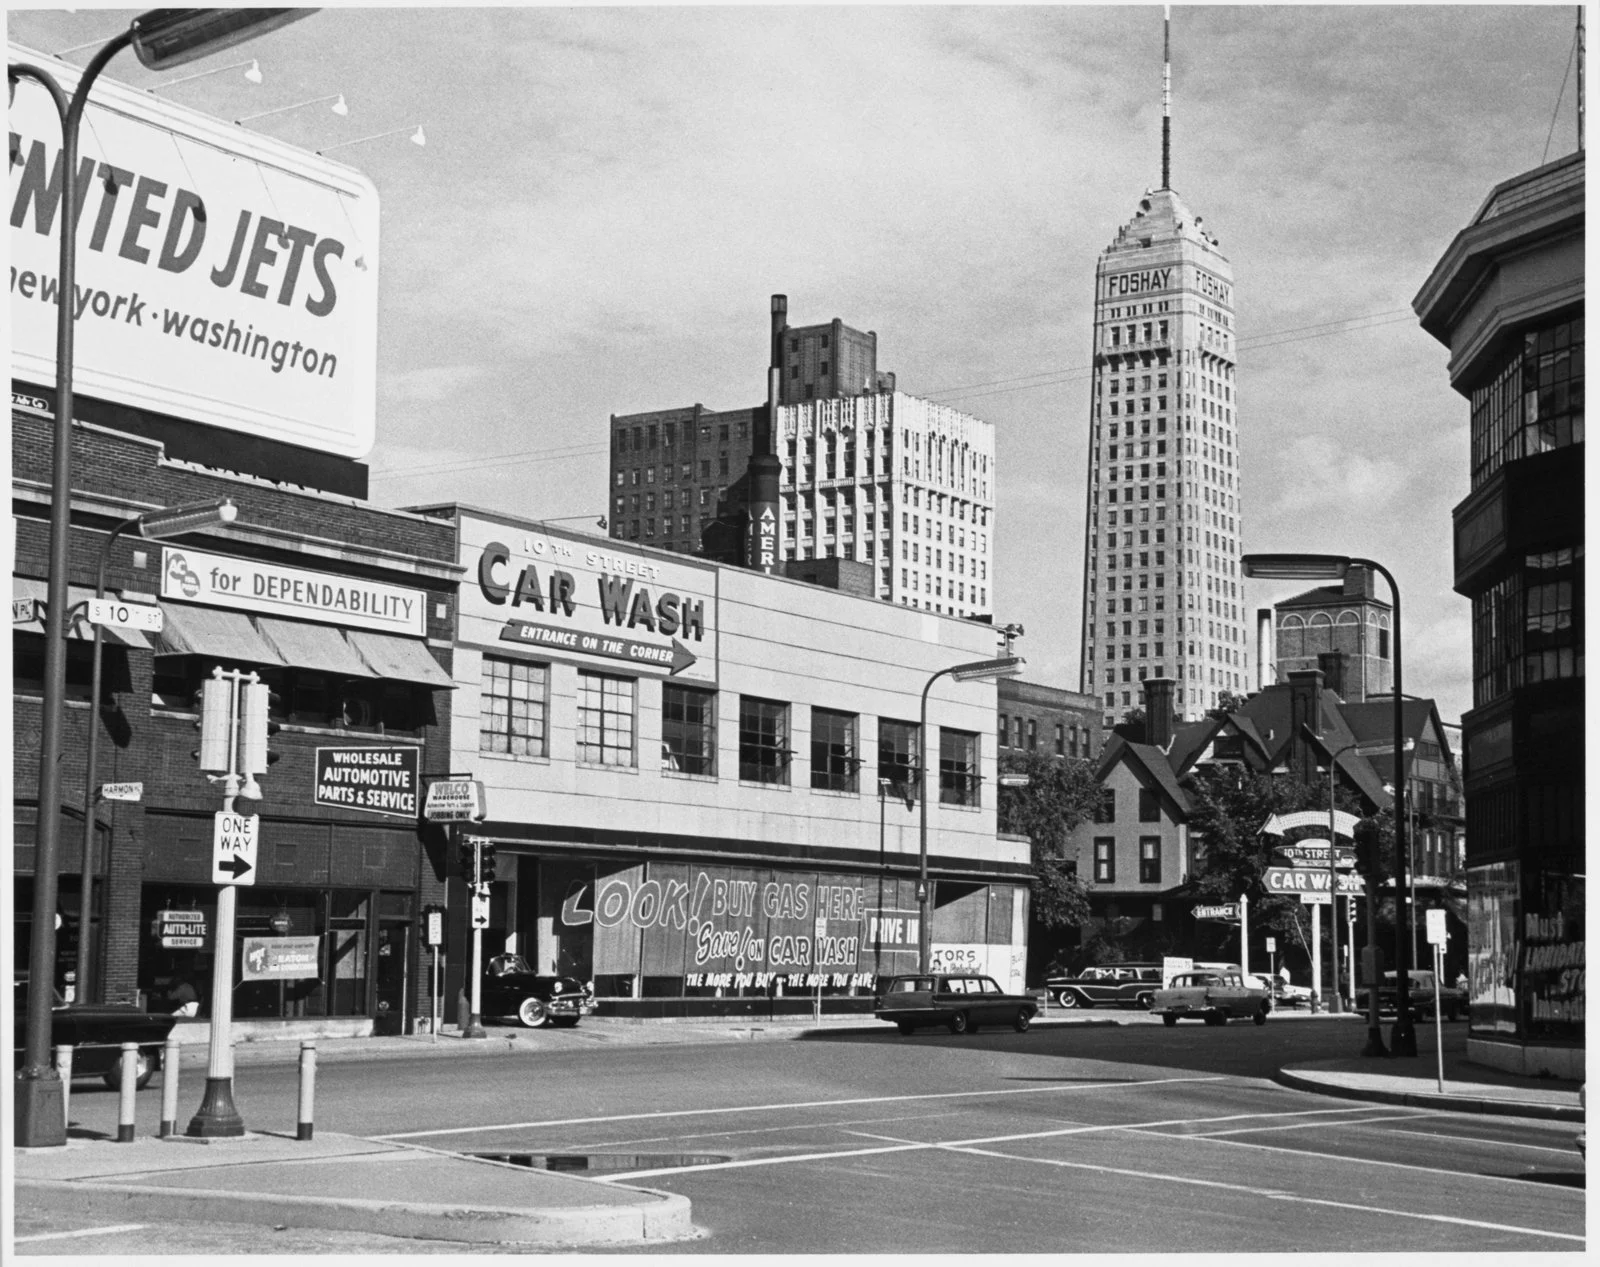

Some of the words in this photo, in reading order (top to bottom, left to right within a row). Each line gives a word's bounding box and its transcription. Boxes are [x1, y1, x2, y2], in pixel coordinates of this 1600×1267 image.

[8, 131, 208, 275] NITED
[209, 208, 346, 318] JETS
[1109, 267, 1172, 296] FOSHAY
[1195, 269, 1231, 304] FOSHAY
[72, 281, 147, 328] york
[162, 308, 338, 379] washington
[586, 550, 661, 579] STREET
[209, 567, 241, 592] for
[252, 572, 414, 620] DEPENDABILITY
[477, 541, 577, 617] CAR
[597, 571, 705, 642] WASH
[519, 625, 577, 646] ENTRANCE
[582, 635, 597, 650] ON
[602, 639, 623, 654] THE
[630, 644, 675, 662] CORNER
[332, 752, 403, 766] WHOLESALE
[103, 785, 134, 794] HARMON
[322, 766, 411, 788] AUTOMOTIVE
[434, 783, 470, 796] WELCO
[318, 784, 355, 803] PARTS
[356, 790, 365, 805] &
[366, 788, 415, 812] SERVICE
[222, 817, 252, 834] ONE
[220, 835, 252, 852] WAY
[1305, 848, 1341, 859] STRET
[1270, 872, 1307, 889] CAR
[561, 871, 711, 937] LOOK!
[712, 879, 758, 917] BUY
[763, 882, 809, 920] GAS
[817, 885, 865, 921] HERE
[1197, 906, 1234, 917] ENTRANCE
[163, 923, 207, 936] AUTO-LITE
[899, 916, 920, 944] IN
[1525, 911, 1565, 940] Must
[170, 938, 198, 946] SERVICE
[747, 938, 765, 962] ON
[768, 935, 812, 966] CAR
[815, 936, 859, 966] WASH
[686, 973, 699, 988] THE
[704, 972, 733, 988] MORE
[754, 971, 777, 988] BUY
[787, 973, 804, 987] THE
[832, 973, 849, 987] YOU
